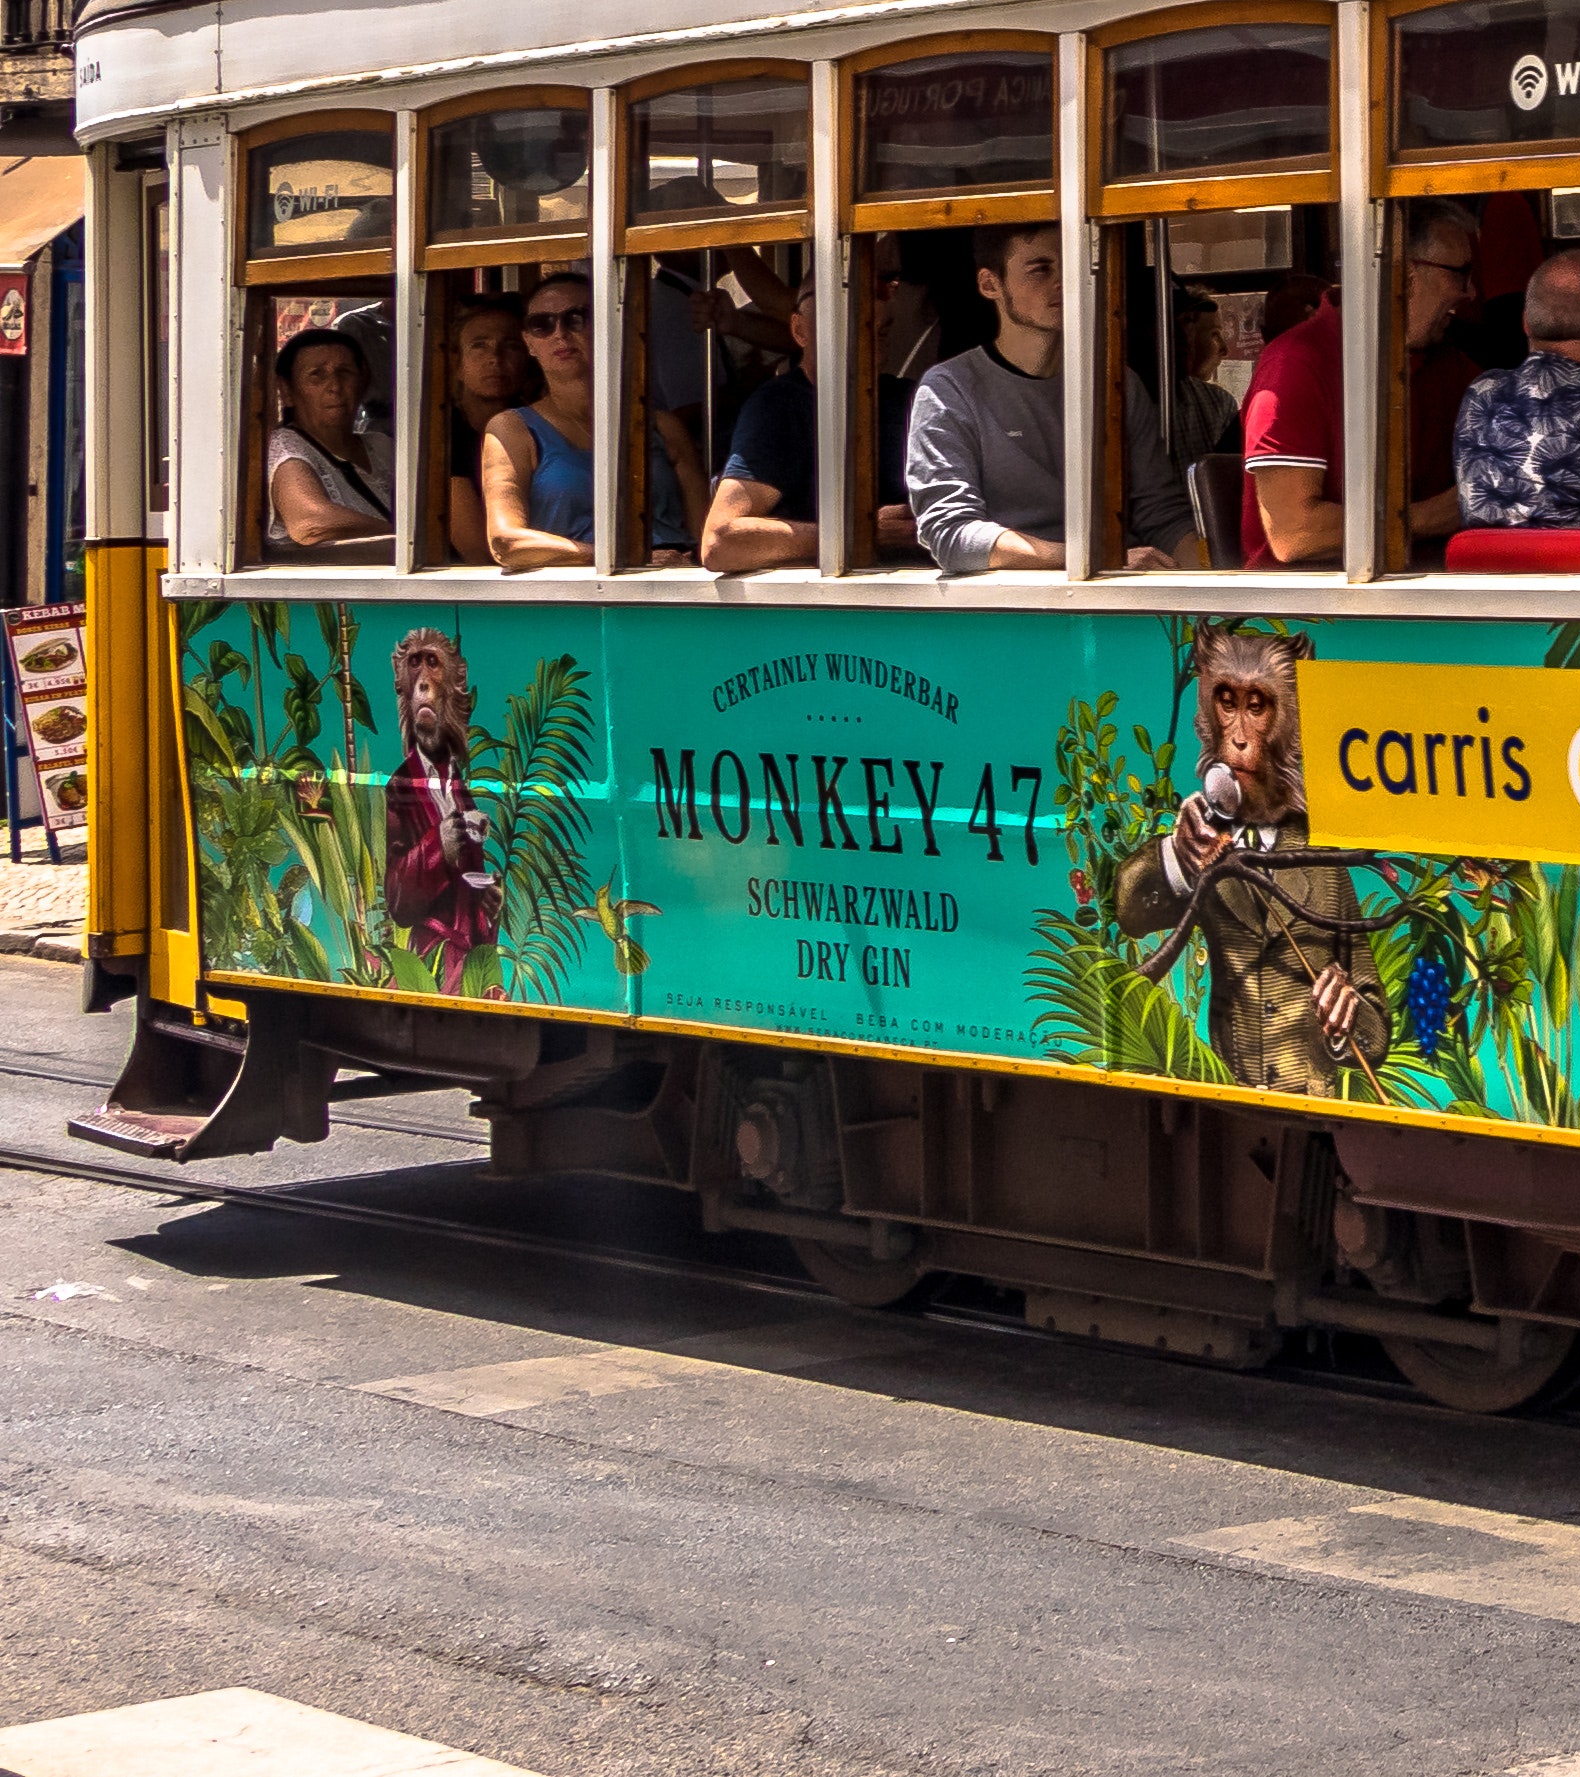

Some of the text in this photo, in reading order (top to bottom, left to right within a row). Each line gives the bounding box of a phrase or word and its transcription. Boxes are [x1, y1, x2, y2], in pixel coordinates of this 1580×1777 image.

[299, 184, 339, 212] WI-FI
[22, 605, 70, 621] KEBAB
[712, 653, 959, 725] CERTAINLY WUNDERBAR
[1338, 706, 1532, 802] carris
[650, 747, 1042, 866] MONKEY 47
[748, 877, 959, 933] SCHWARZWALD
[796, 939, 911, 988] DRY GIN
[666, 992, 703, 1007] SEJA
[714, 997, 828, 1022] RESPONSÁVEL
[855, 1013, 899, 1029] BEBA
[910, 1018, 944, 1034] COM
